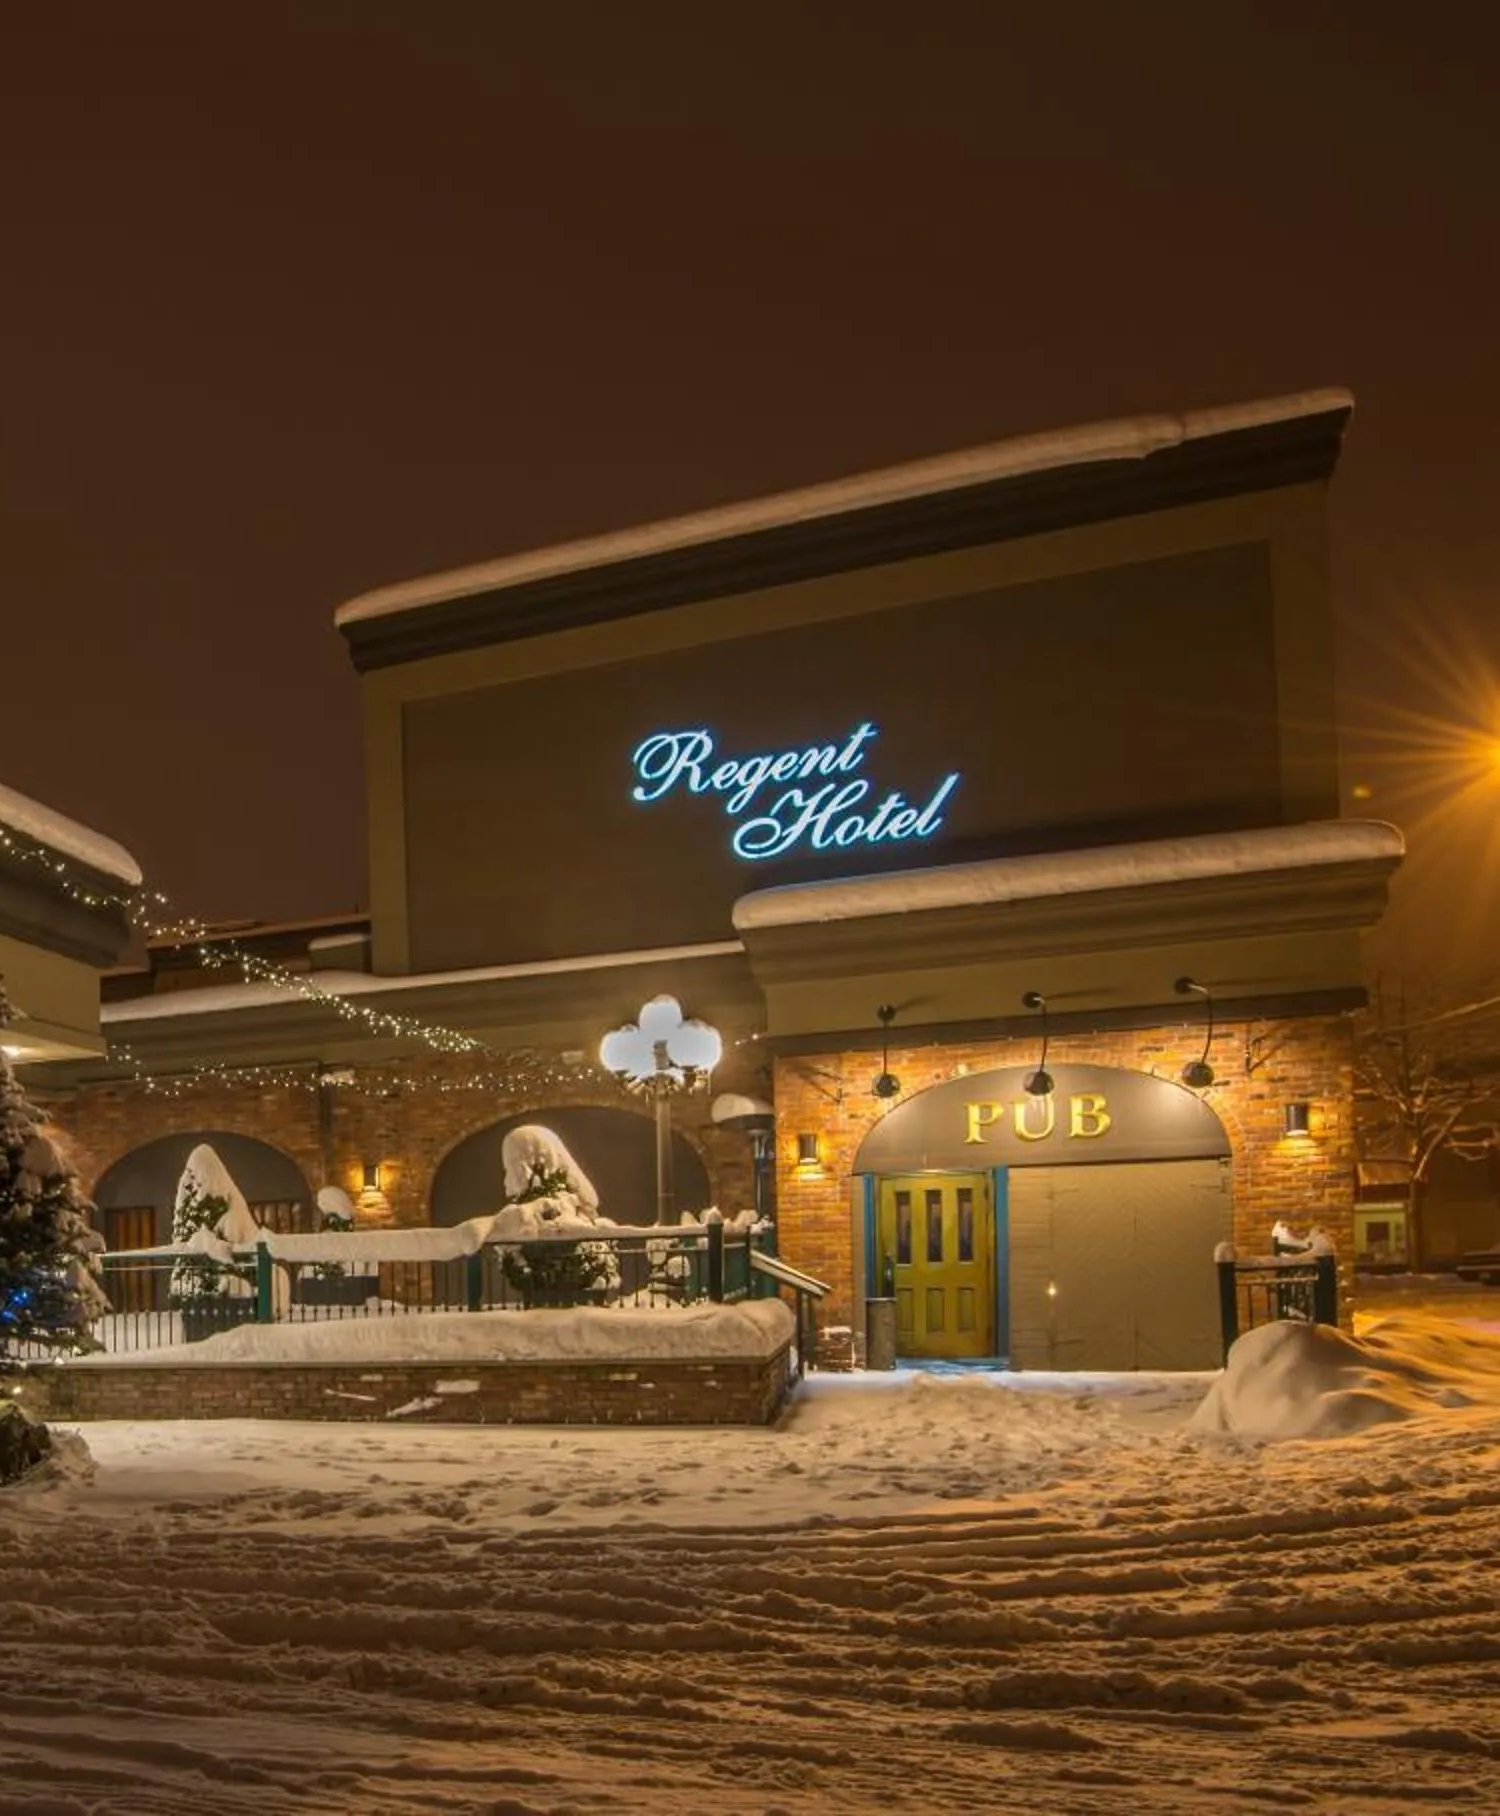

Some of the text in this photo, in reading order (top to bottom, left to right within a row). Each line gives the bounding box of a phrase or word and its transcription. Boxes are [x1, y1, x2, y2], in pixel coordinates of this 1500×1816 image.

[632, 720, 878, 814] Regent
[732, 772, 960, 860] Hotel
[963, 1092, 1112, 1144] PUB
